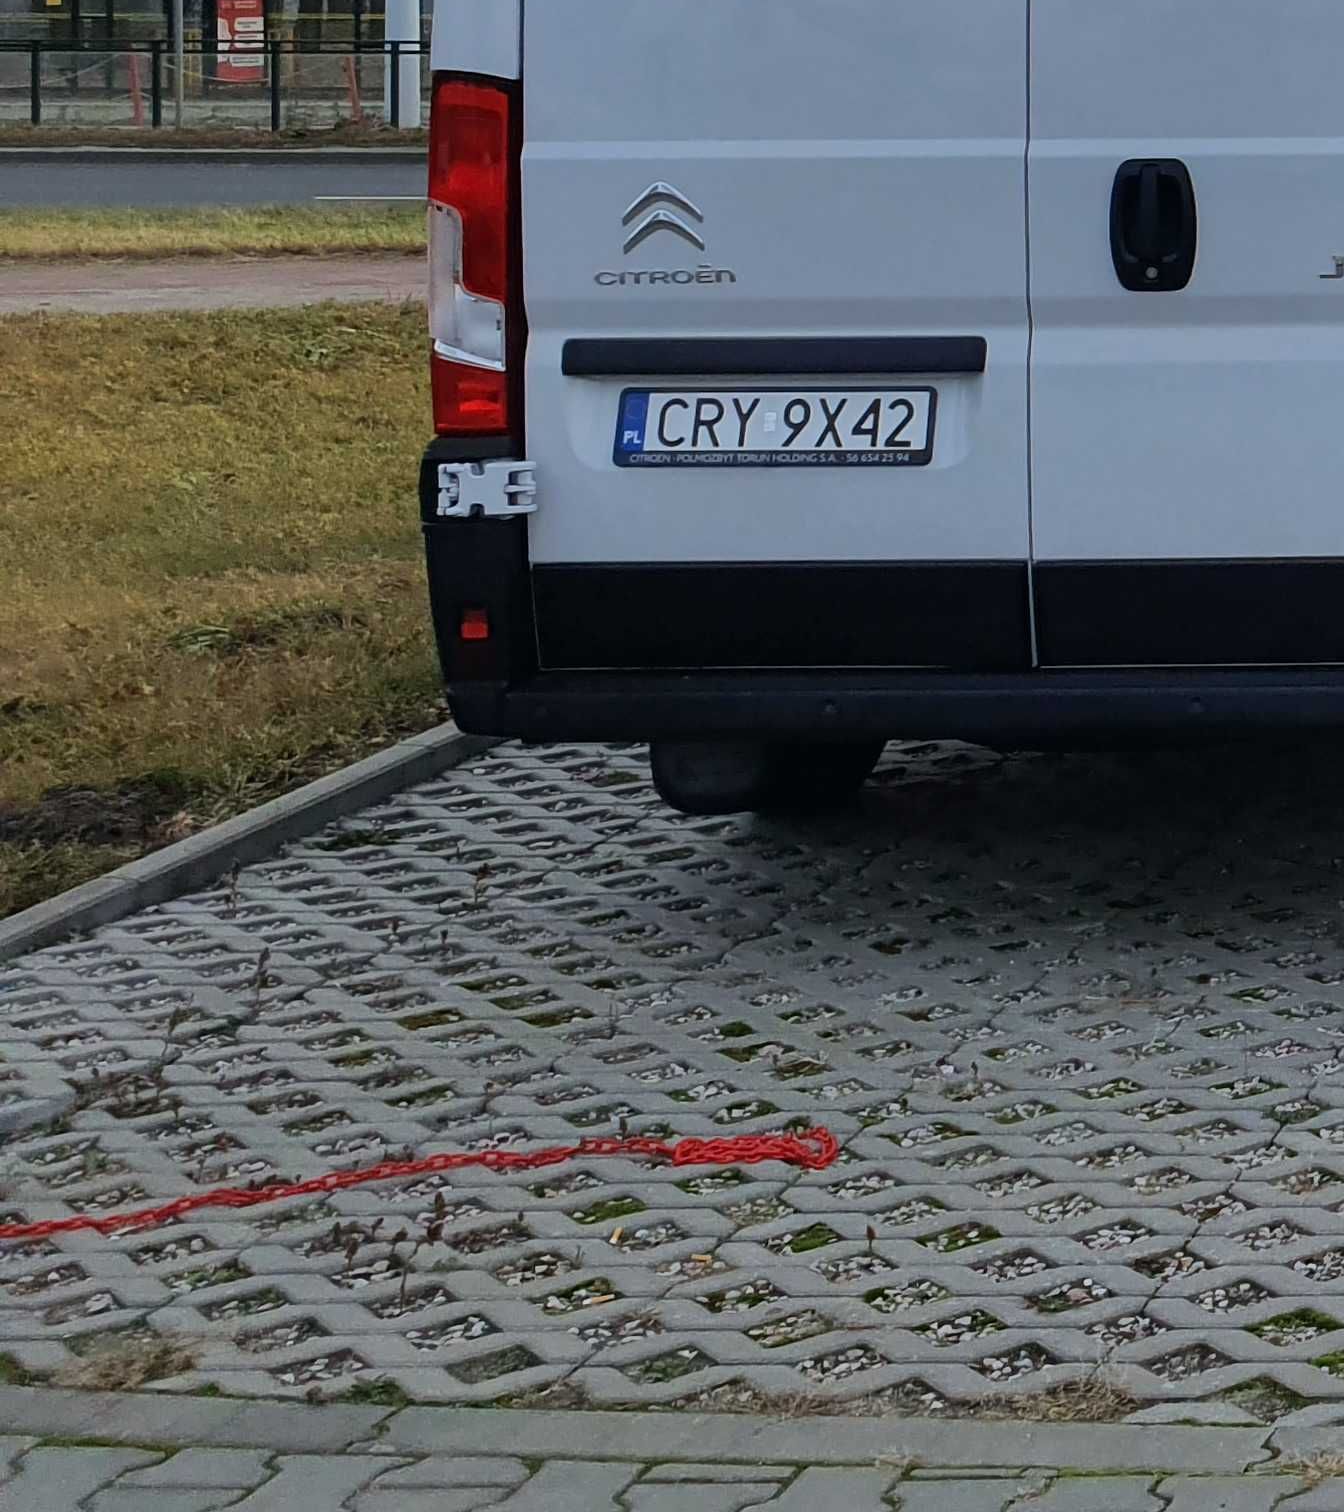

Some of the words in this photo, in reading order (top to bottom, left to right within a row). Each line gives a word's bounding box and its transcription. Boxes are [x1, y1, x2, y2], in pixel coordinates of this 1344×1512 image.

[623, 430, 642, 444] PL
[657, 397, 761, 448] CRY
[781, 397, 915, 448] 9X42
